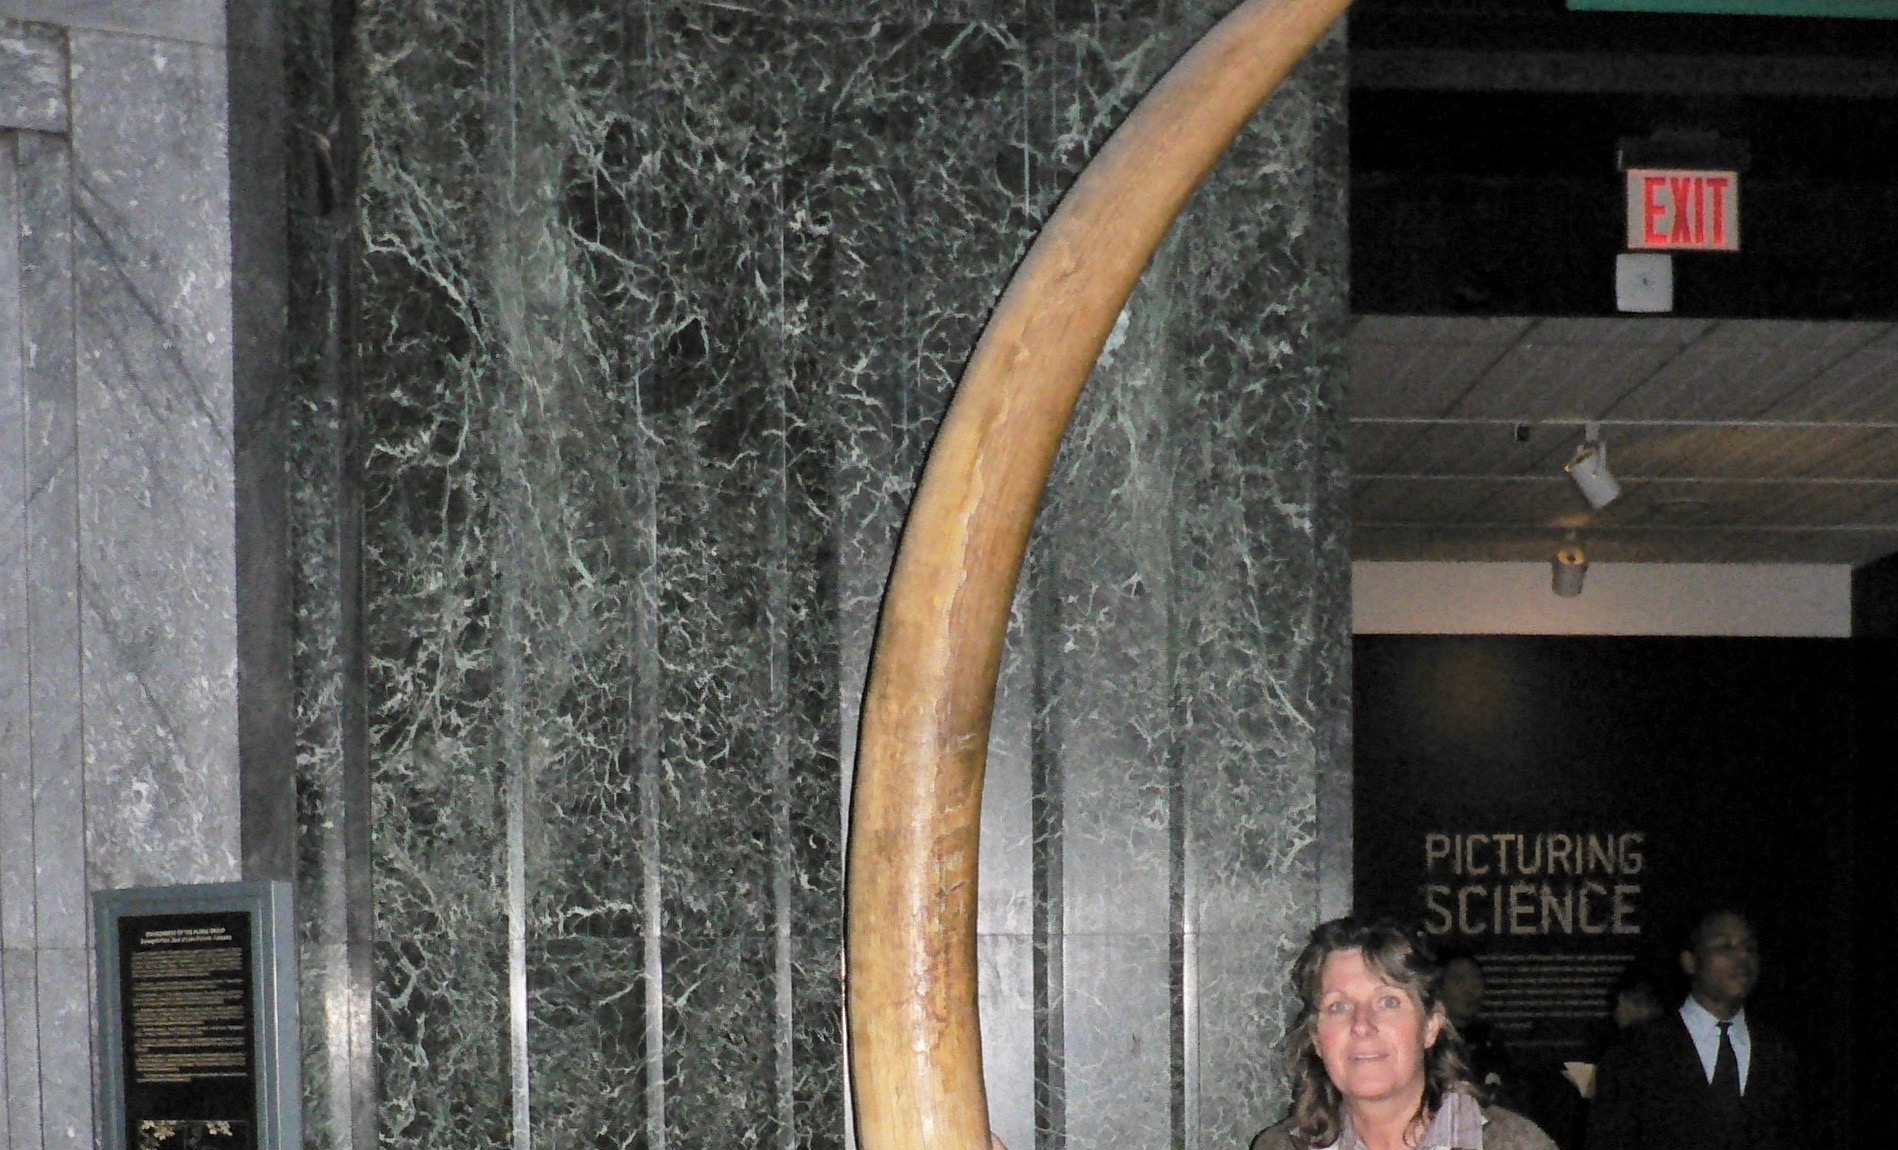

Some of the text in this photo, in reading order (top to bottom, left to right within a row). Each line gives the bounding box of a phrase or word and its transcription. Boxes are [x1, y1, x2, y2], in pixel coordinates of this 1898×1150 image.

[1644, 177, 1728, 246] EXIT
[1424, 832, 1645, 876] PICTURING
[1424, 882, 1642, 936] SCIENCE
